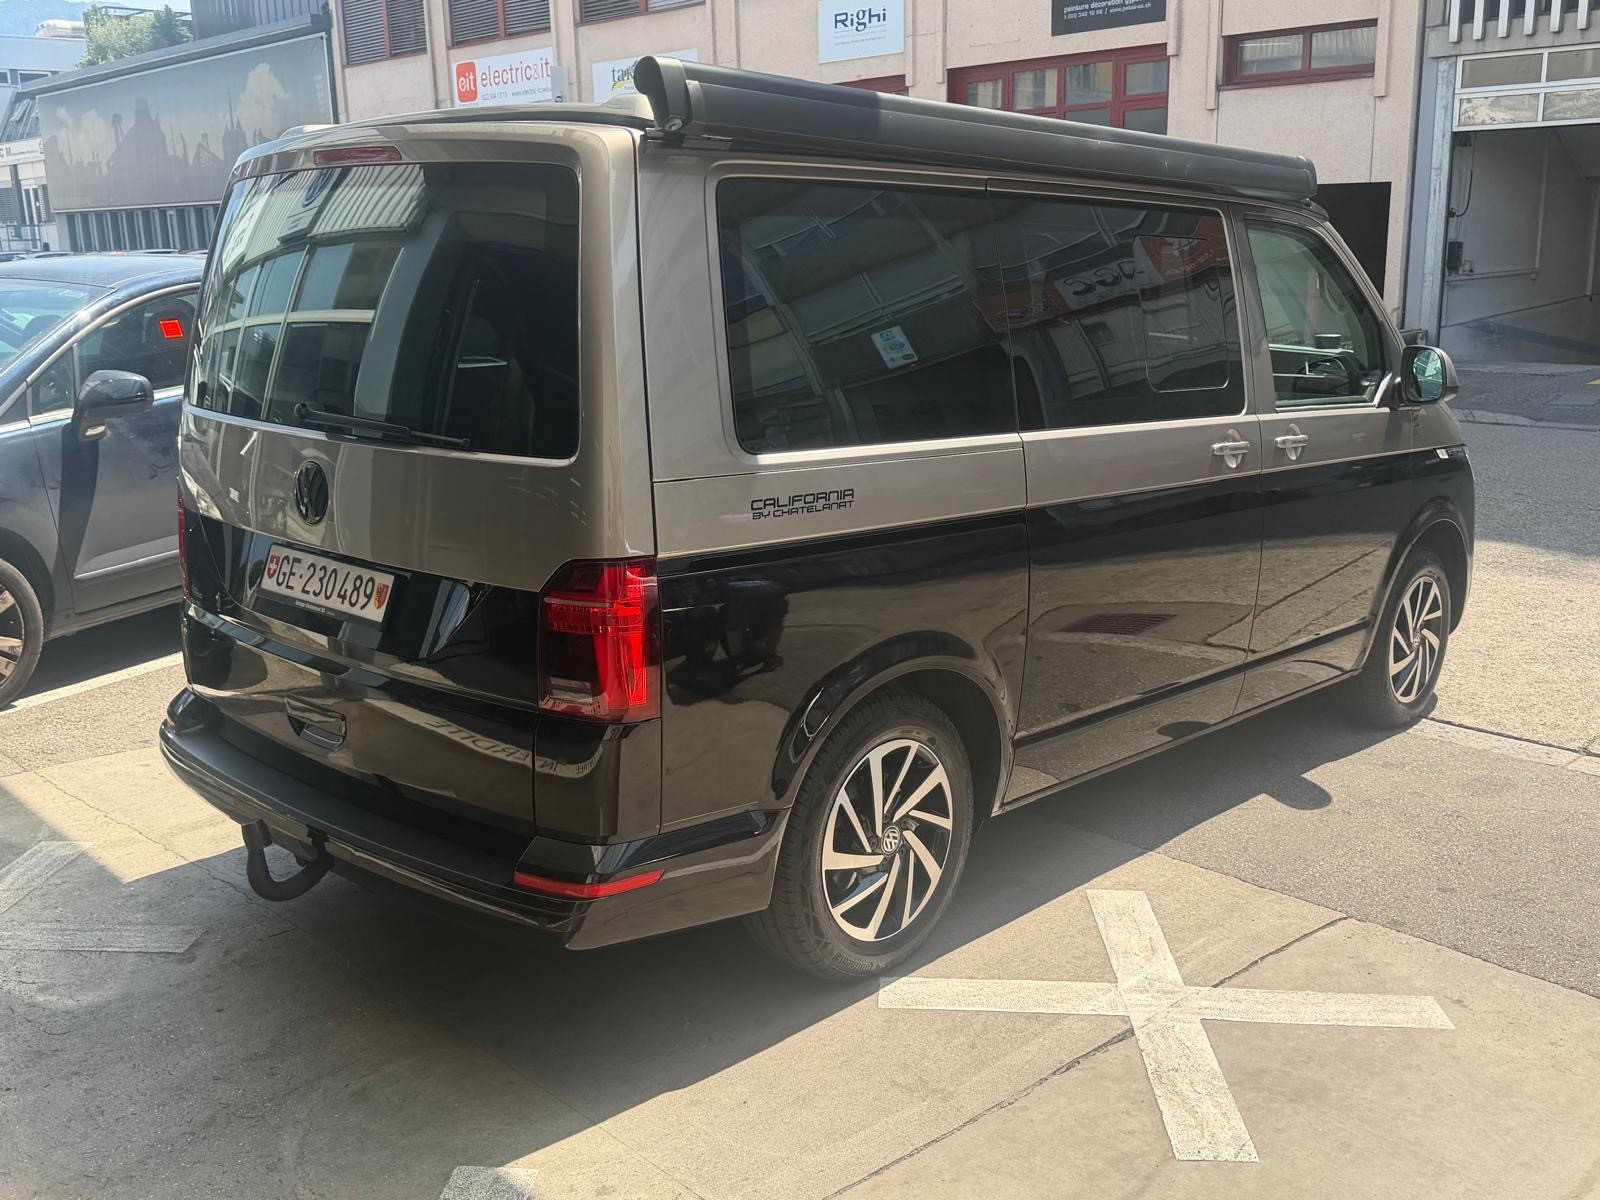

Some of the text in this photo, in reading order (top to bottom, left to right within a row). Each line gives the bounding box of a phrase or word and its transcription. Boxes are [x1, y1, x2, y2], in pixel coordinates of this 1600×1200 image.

[834, 7, 887, 32] Righi
[458, 72, 476, 92] eit
[750, 488, 855, 511] CALIFORNIA
[752, 500, 855, 520] BY CHATELANAT
